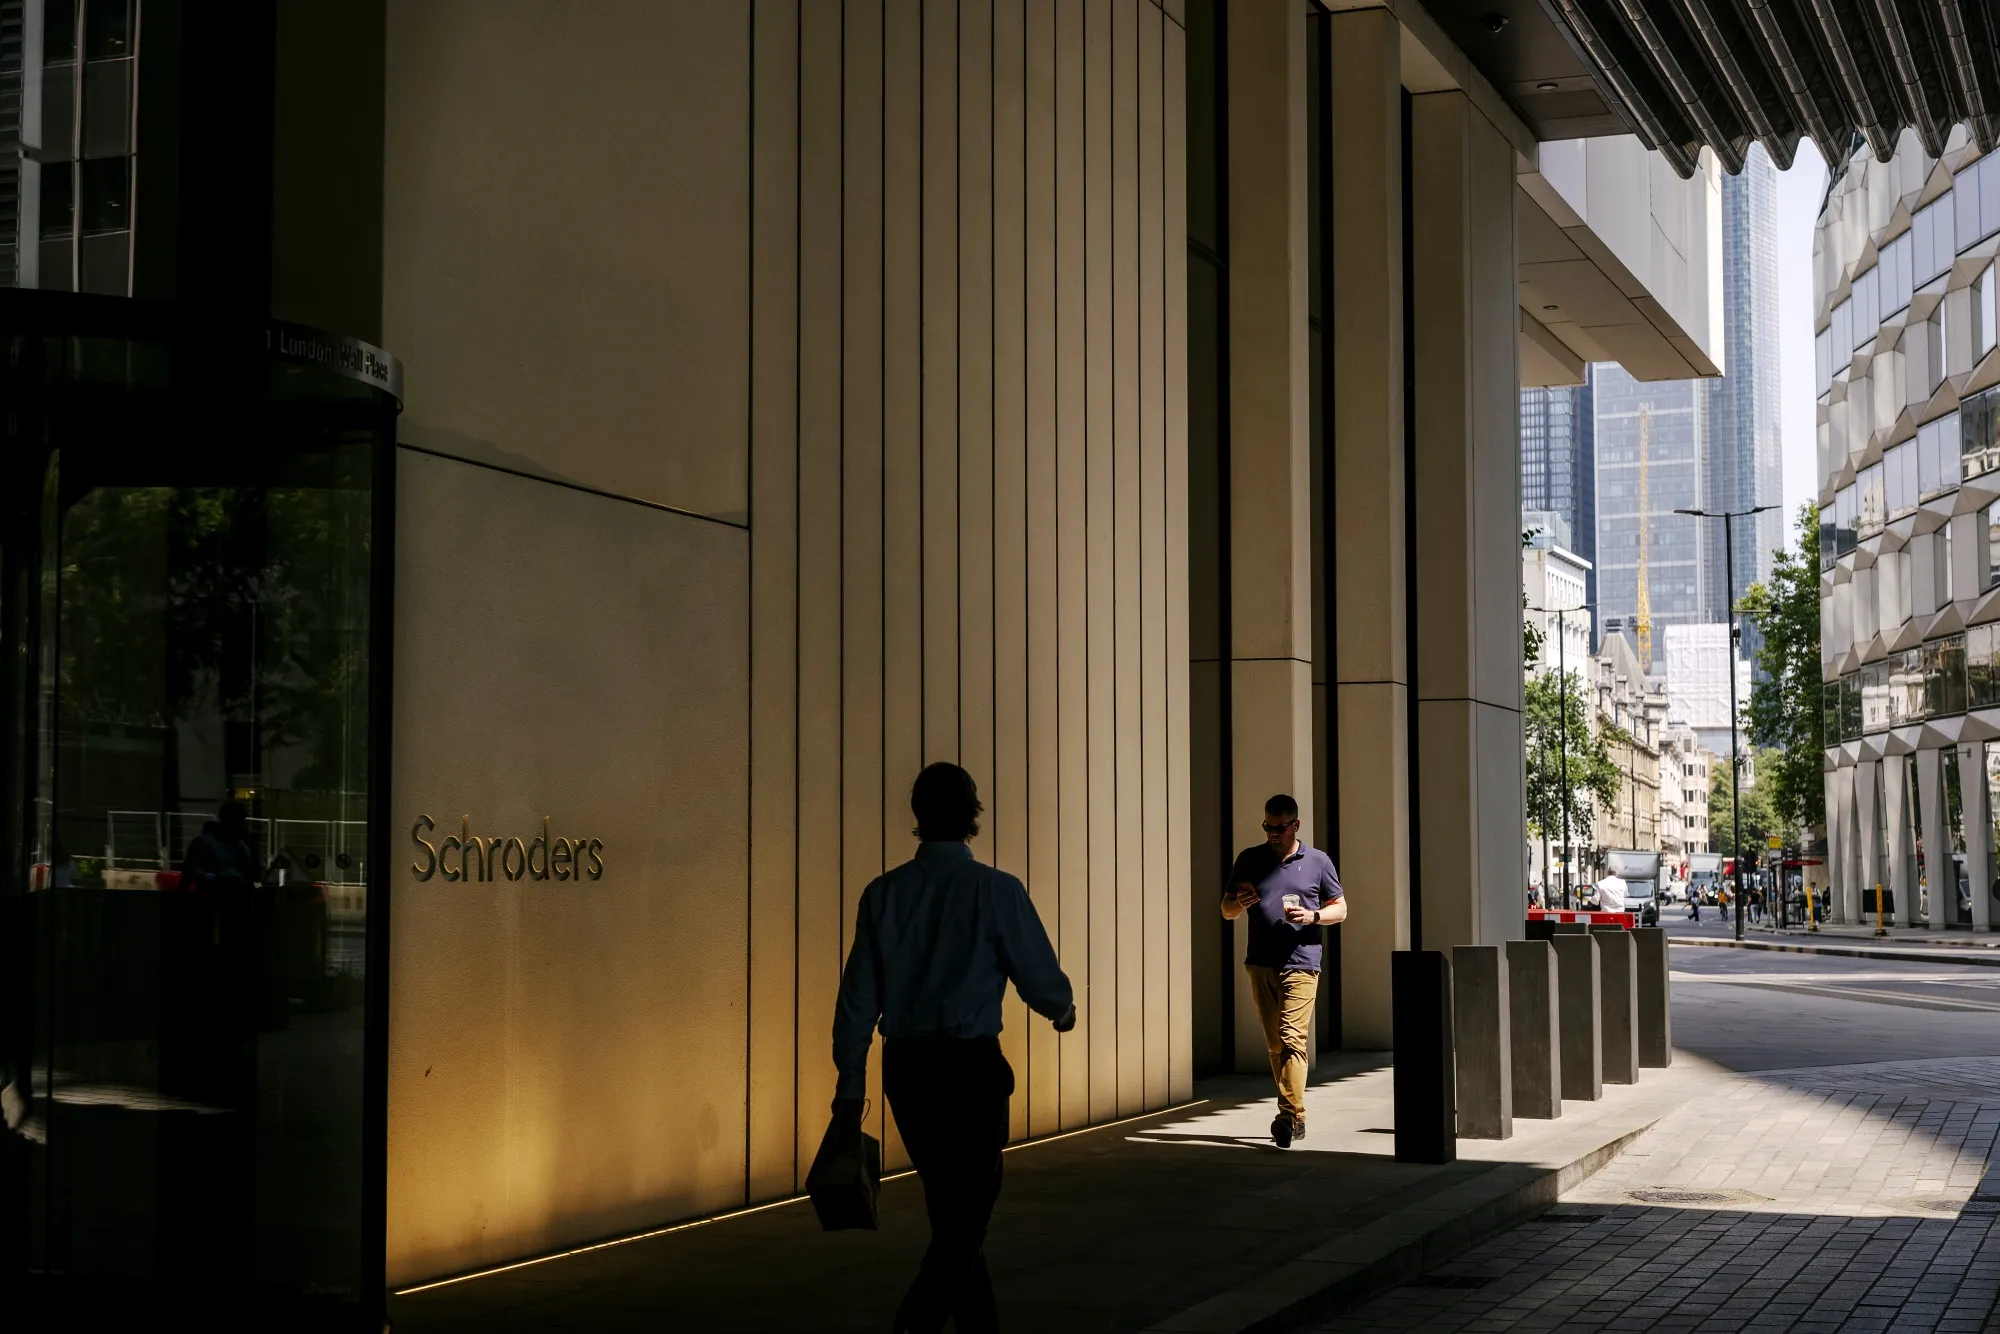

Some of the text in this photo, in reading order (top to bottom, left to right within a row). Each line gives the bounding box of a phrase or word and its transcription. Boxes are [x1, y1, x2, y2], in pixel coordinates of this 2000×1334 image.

[264, 327, 388, 382] 1 London Wall Place
[412, 814, 603, 882] Schroders
